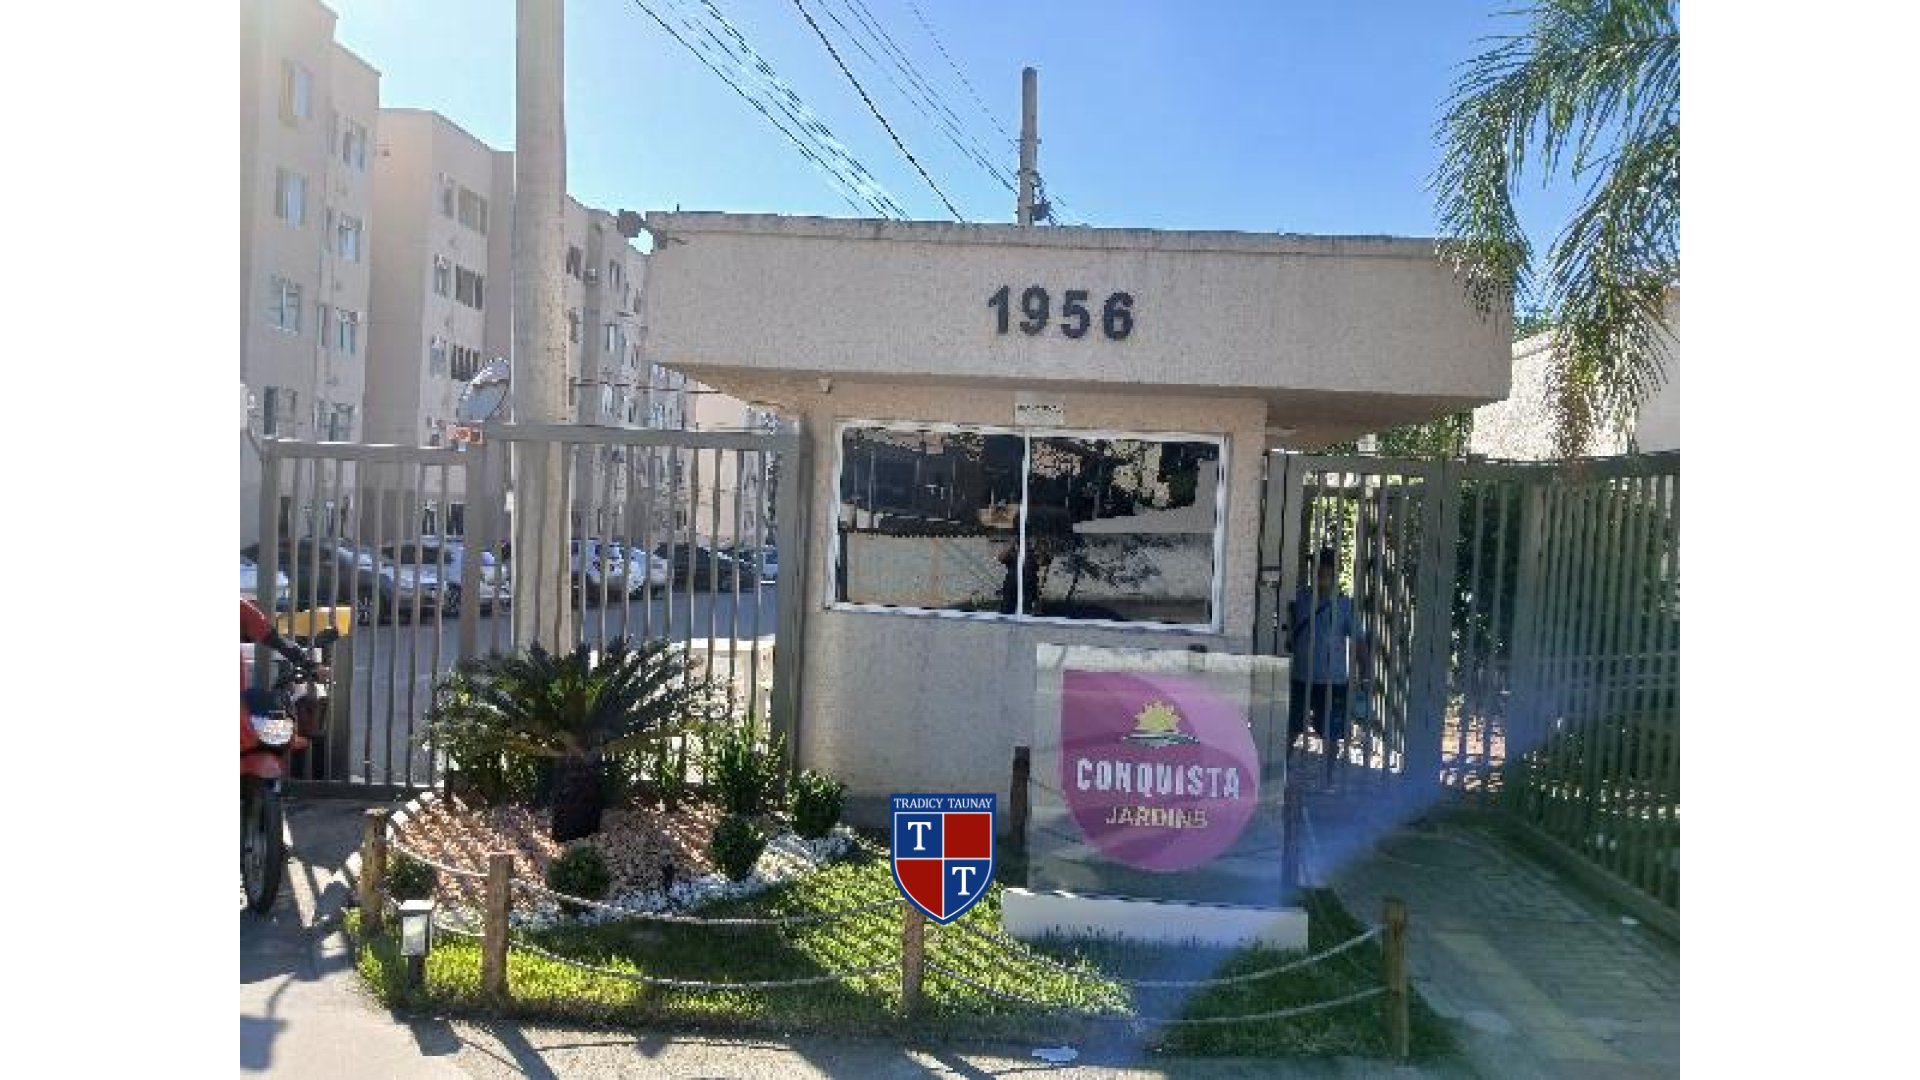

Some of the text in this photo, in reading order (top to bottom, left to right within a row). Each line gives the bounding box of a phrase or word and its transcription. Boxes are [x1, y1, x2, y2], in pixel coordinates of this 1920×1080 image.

[988, 284, 1134, 341] 1956
[1076, 757, 1240, 800] CONQUISTA
[1105, 805, 1208, 829] JARDINS
